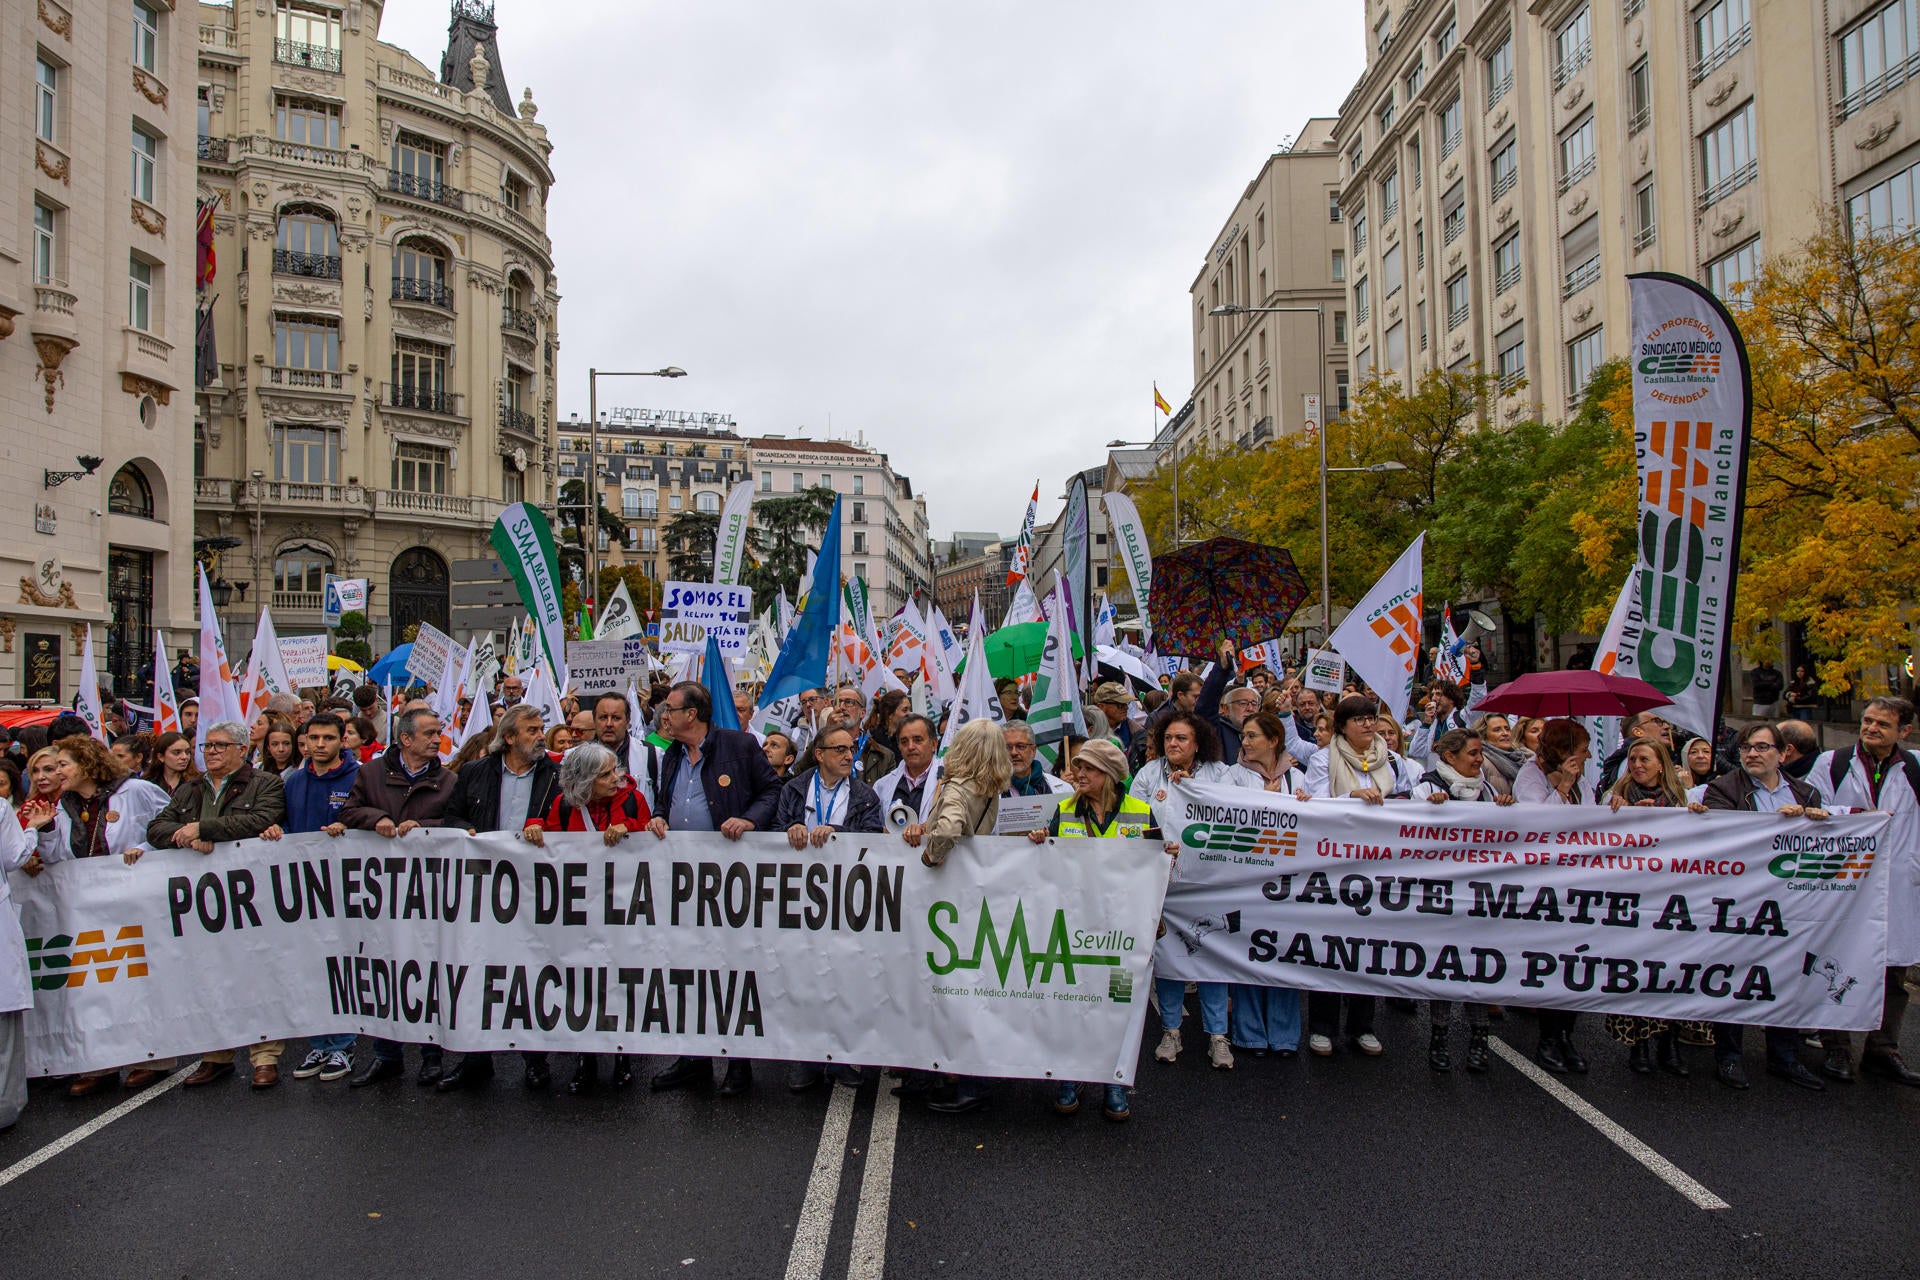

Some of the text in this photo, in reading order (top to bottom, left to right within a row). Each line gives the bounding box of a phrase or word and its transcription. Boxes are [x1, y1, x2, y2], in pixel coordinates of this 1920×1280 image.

[1646, 317, 1715, 342] TU PROFESIÓN
[1641, 338, 1722, 356] SINDICATO MÉDICO
[1638, 354, 1721, 375] CESM
[1687, 375, 1716, 384] Mancha
[1649, 387, 1710, 405] DEFIÉNDELA
[613, 407, 733, 425] HOTEL VILLA REAL
[755, 451, 797, 459] ORGANIZACIÓN
[1708, 428, 1735, 524] Mancha
[720, 513, 739, 573] Málaga
[1705, 535, 1724, 563] La
[511, 518, 558, 625] SMA Málaga
[667, 588, 746, 608] SOMOS EL
[1366, 583, 1420, 623] cesmcv
[719, 612, 737, 622] TU
[662, 622, 746, 643] SALUD ESTÁ EN
[1695, 595, 1719, 690] Castilla
[624, 642, 640, 652] NO
[570, 666, 625, 679] ESTATUTO
[583, 680, 617, 689] MARCO
[1185, 803, 1299, 830] SINDICATO MÉDICO
[1181, 823, 1299, 857] CESM
[1399, 824, 1660, 848] MINISTERIO DE SANIDAD:
[1772, 834, 1834, 853] SINDICATO
[1199, 852, 1227, 864] Castilla
[1233, 855, 1243, 865] La
[1245, 856, 1275, 868] Mancha
[1316, 837, 1747, 877] ÚLTIMA PROPUESTA DE ESTATUTO MARCO
[1768, 853, 1876, 879] CESM
[167, 847, 905, 937] POR UN ESTATUTO DE LA PROFESIÓN
[1820, 882, 1830, 891] La
[1830, 882, 1857, 891] Mancha
[1261, 871, 1790, 938] JAQUE MATE A LA
[926, 895, 1136, 991] SMA Sevilla
[26, 924, 149, 991] SM
[1248, 928, 1777, 1002] SANIDAD PÚBLICA
[325, 941, 765, 1038] MÉDICA Y FACULTATIVA
[931, 984, 969, 997] Sindicato
[974, 985, 1008, 998] Médico
[1009, 988, 1045, 1000] Andaluz
[1053, 991, 1103, 1003] Federación
